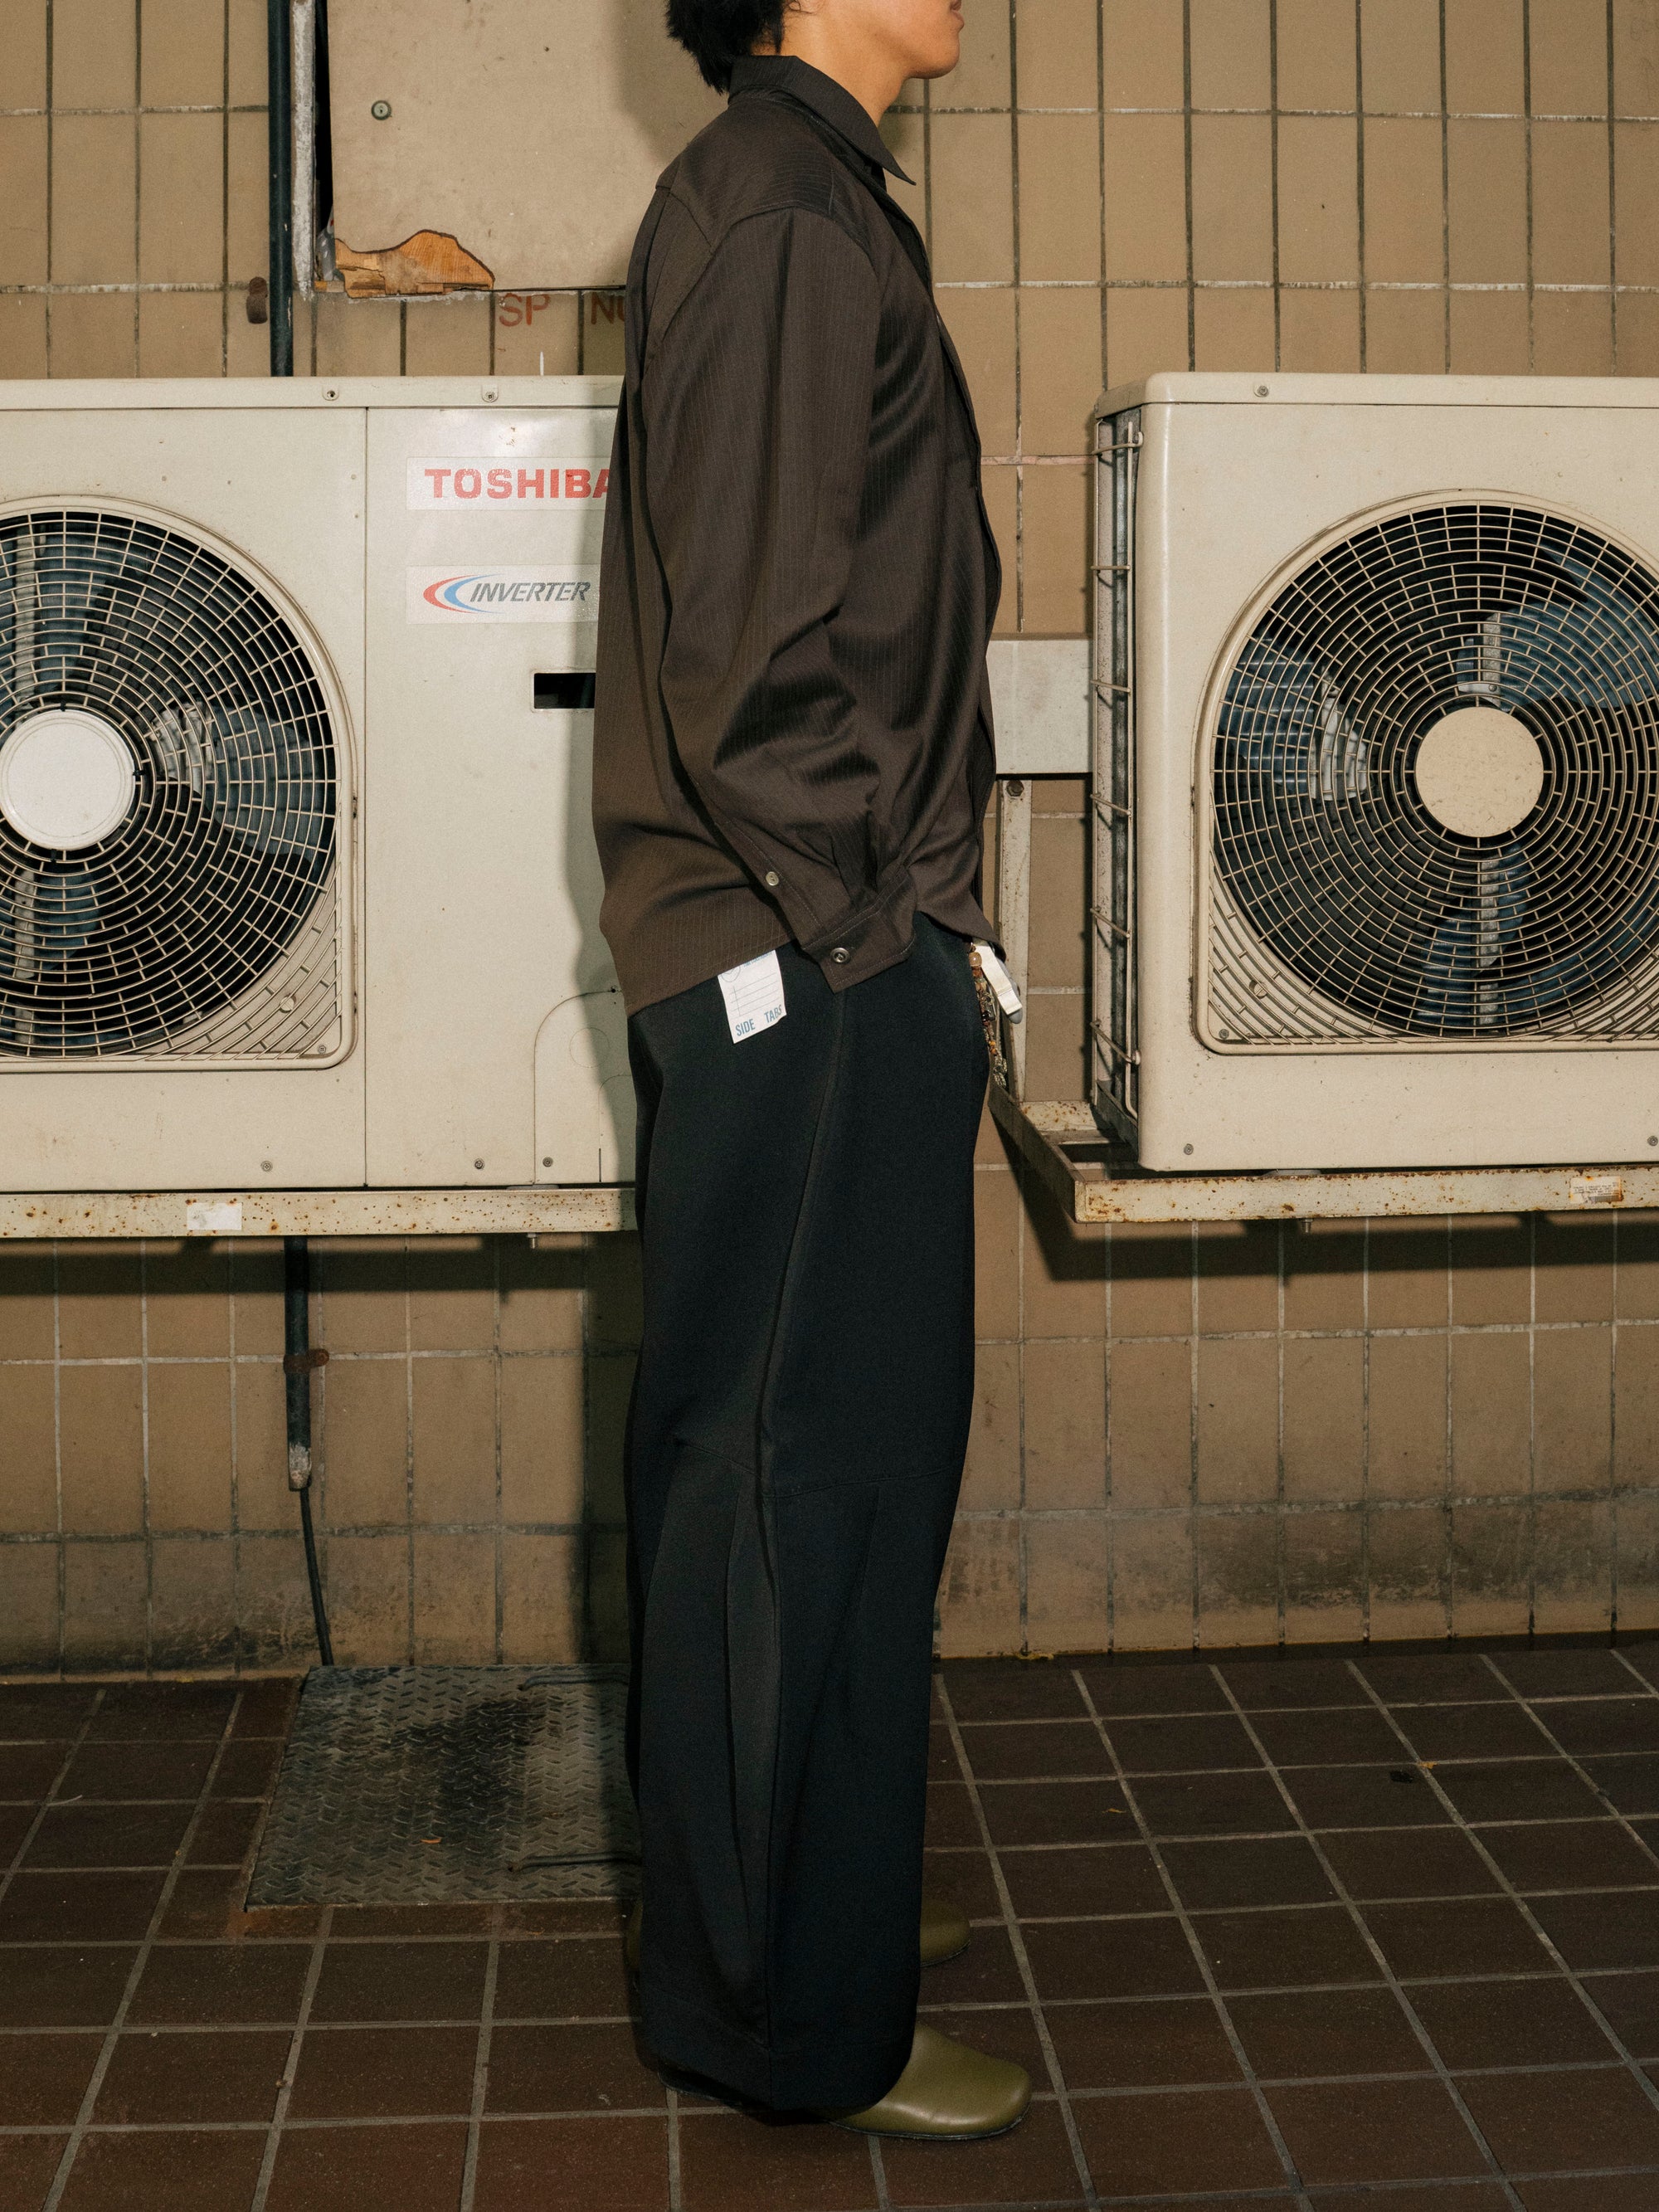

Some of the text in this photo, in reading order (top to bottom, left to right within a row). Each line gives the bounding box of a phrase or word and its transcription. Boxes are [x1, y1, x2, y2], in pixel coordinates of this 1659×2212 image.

[499, 292, 551, 327] SP
[469, 581, 591, 603] INVERTER
[735, 1004, 782, 1036] SIDE TABS
